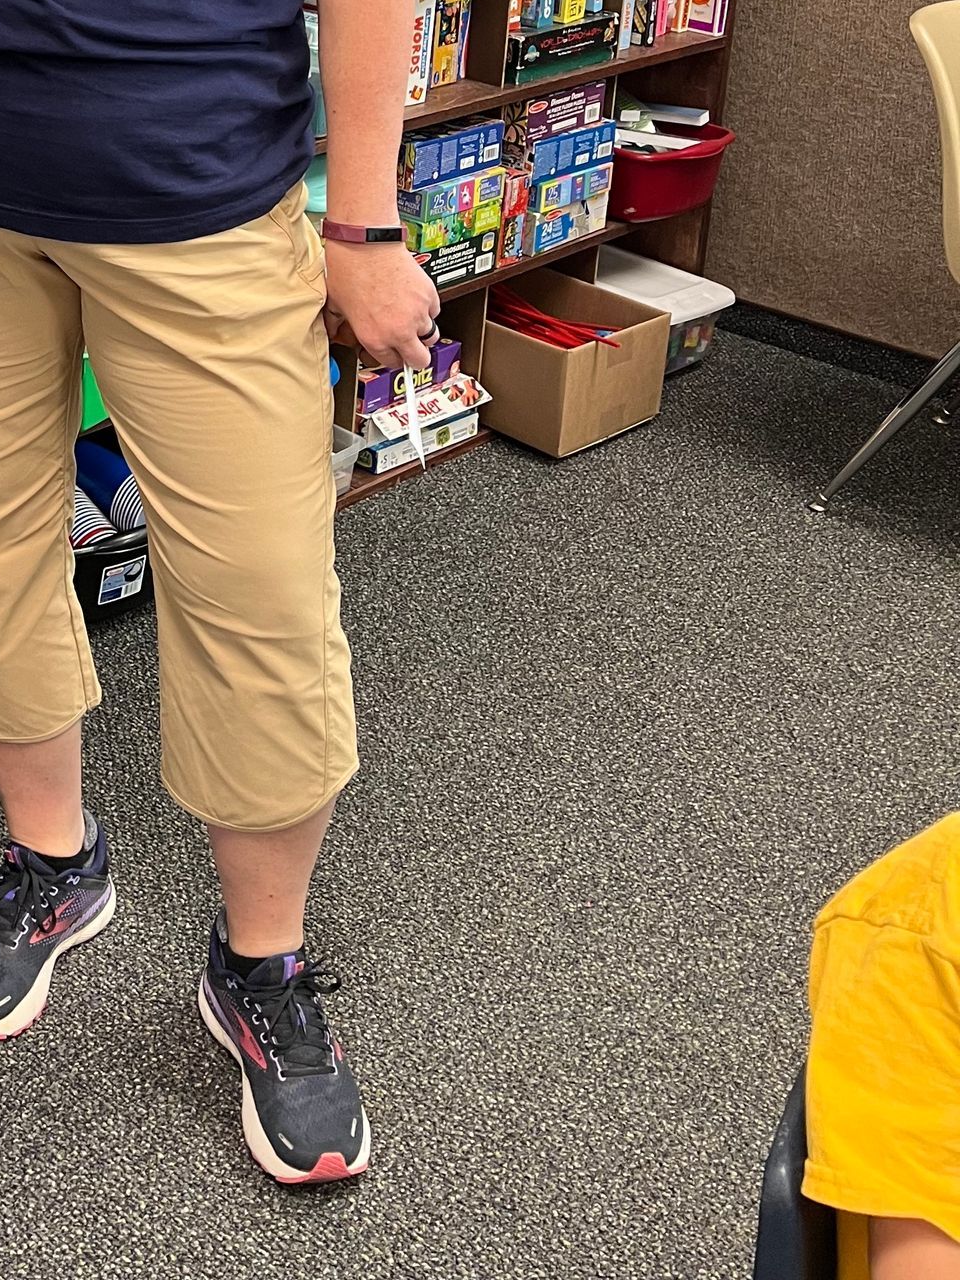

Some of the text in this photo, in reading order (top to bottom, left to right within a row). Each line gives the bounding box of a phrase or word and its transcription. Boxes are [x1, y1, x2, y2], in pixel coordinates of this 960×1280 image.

[623, 2, 632, 29] GAME
[409, 15, 425, 75] WORDS
[433, 192, 446, 209] 25
[547, 185, 559, 201] 25
[541, 221, 553, 237] 24
[438, 240, 470, 257] Dinosaurs
